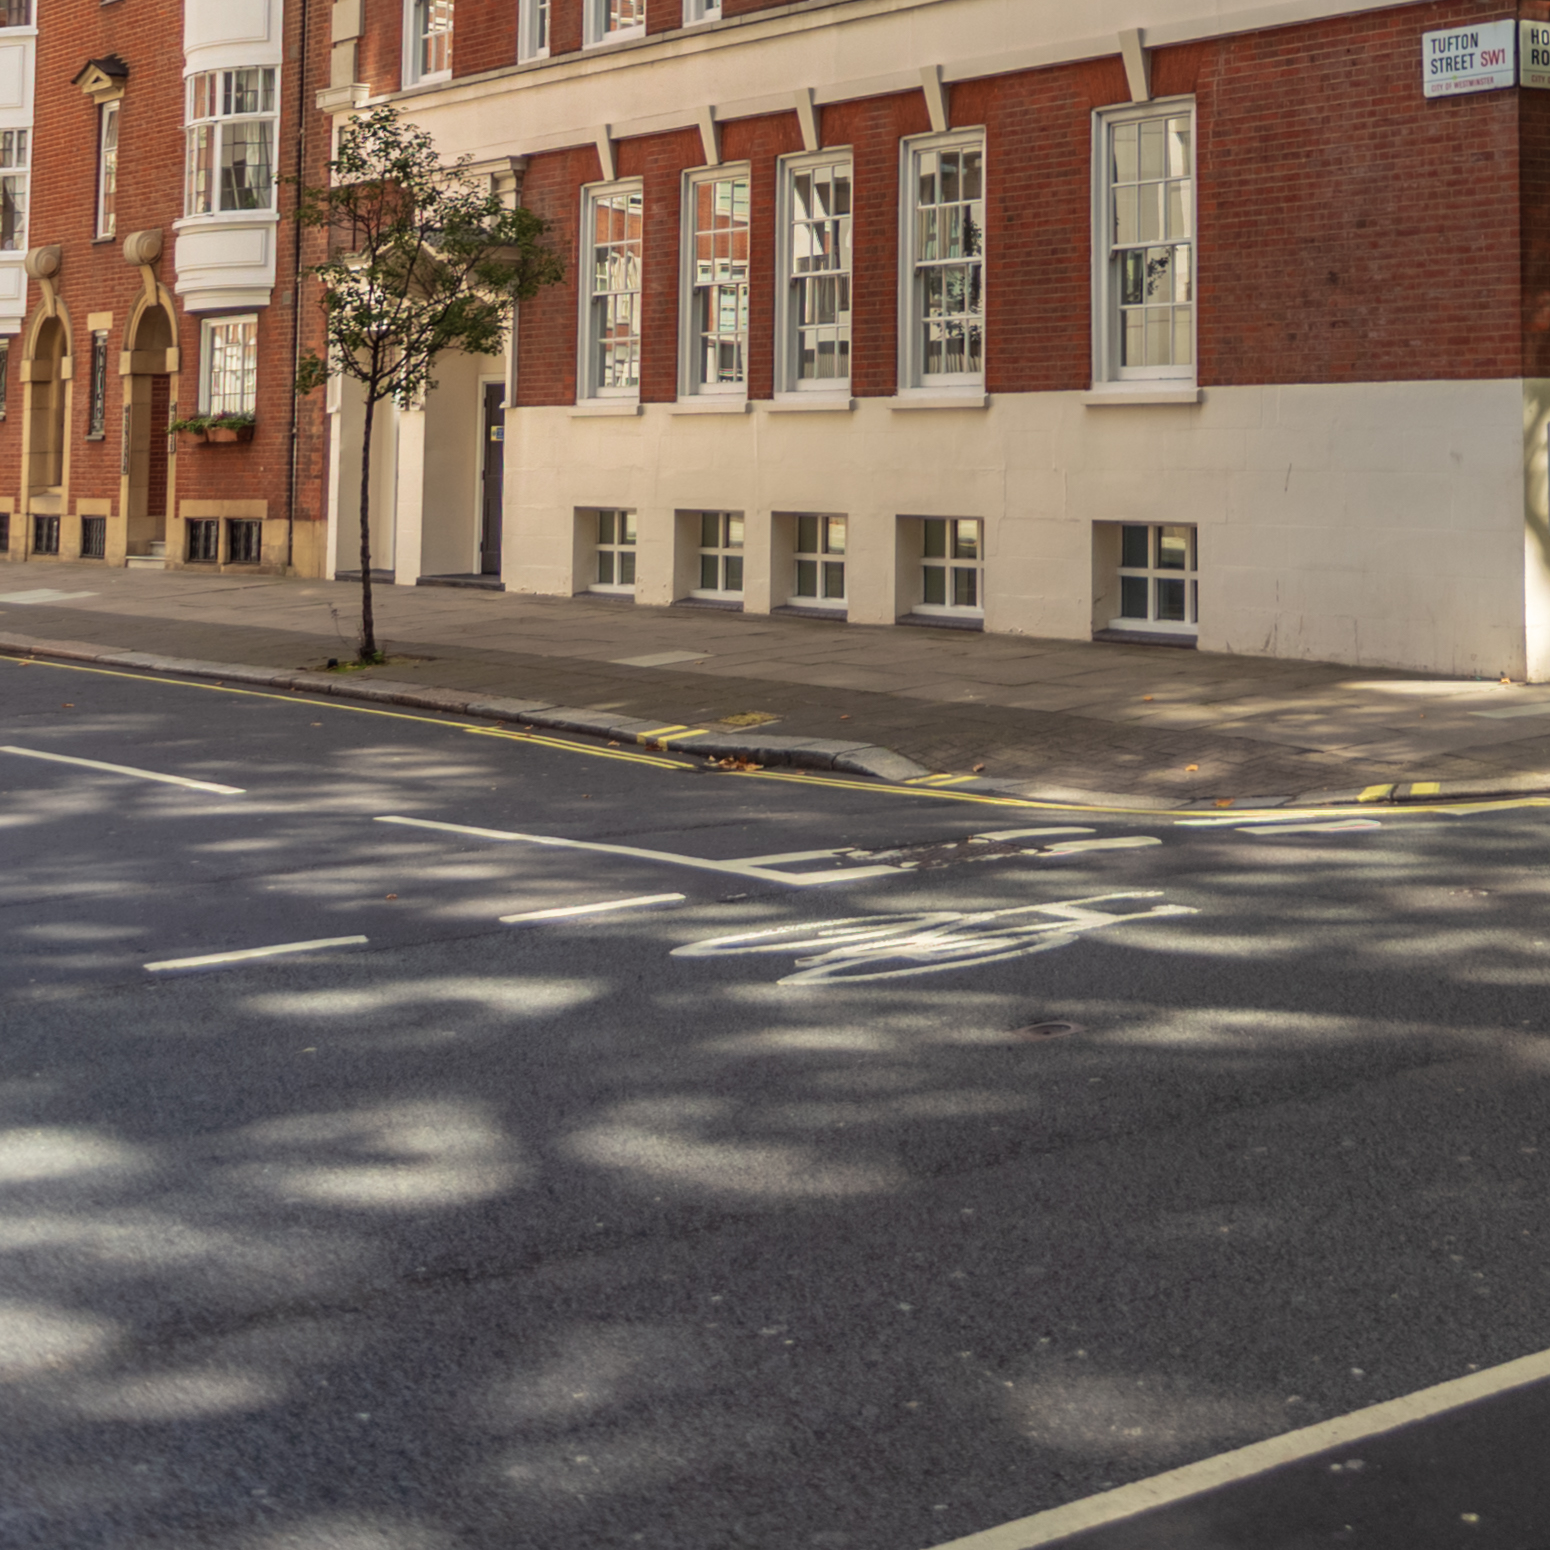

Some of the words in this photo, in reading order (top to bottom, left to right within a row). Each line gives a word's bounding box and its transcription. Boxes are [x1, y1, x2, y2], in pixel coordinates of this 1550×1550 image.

[1431, 32, 1479, 54] TUFTON
[1431, 52, 1475, 75] STREET
[1480, 48, 1505, 67] SW1
[1431, 83, 1443, 93] CITY
[1445, 82, 1452, 90] OF
[1454, 76, 1494, 90] WESTMINSTER
[1531, 74, 1545, 84] CITY
